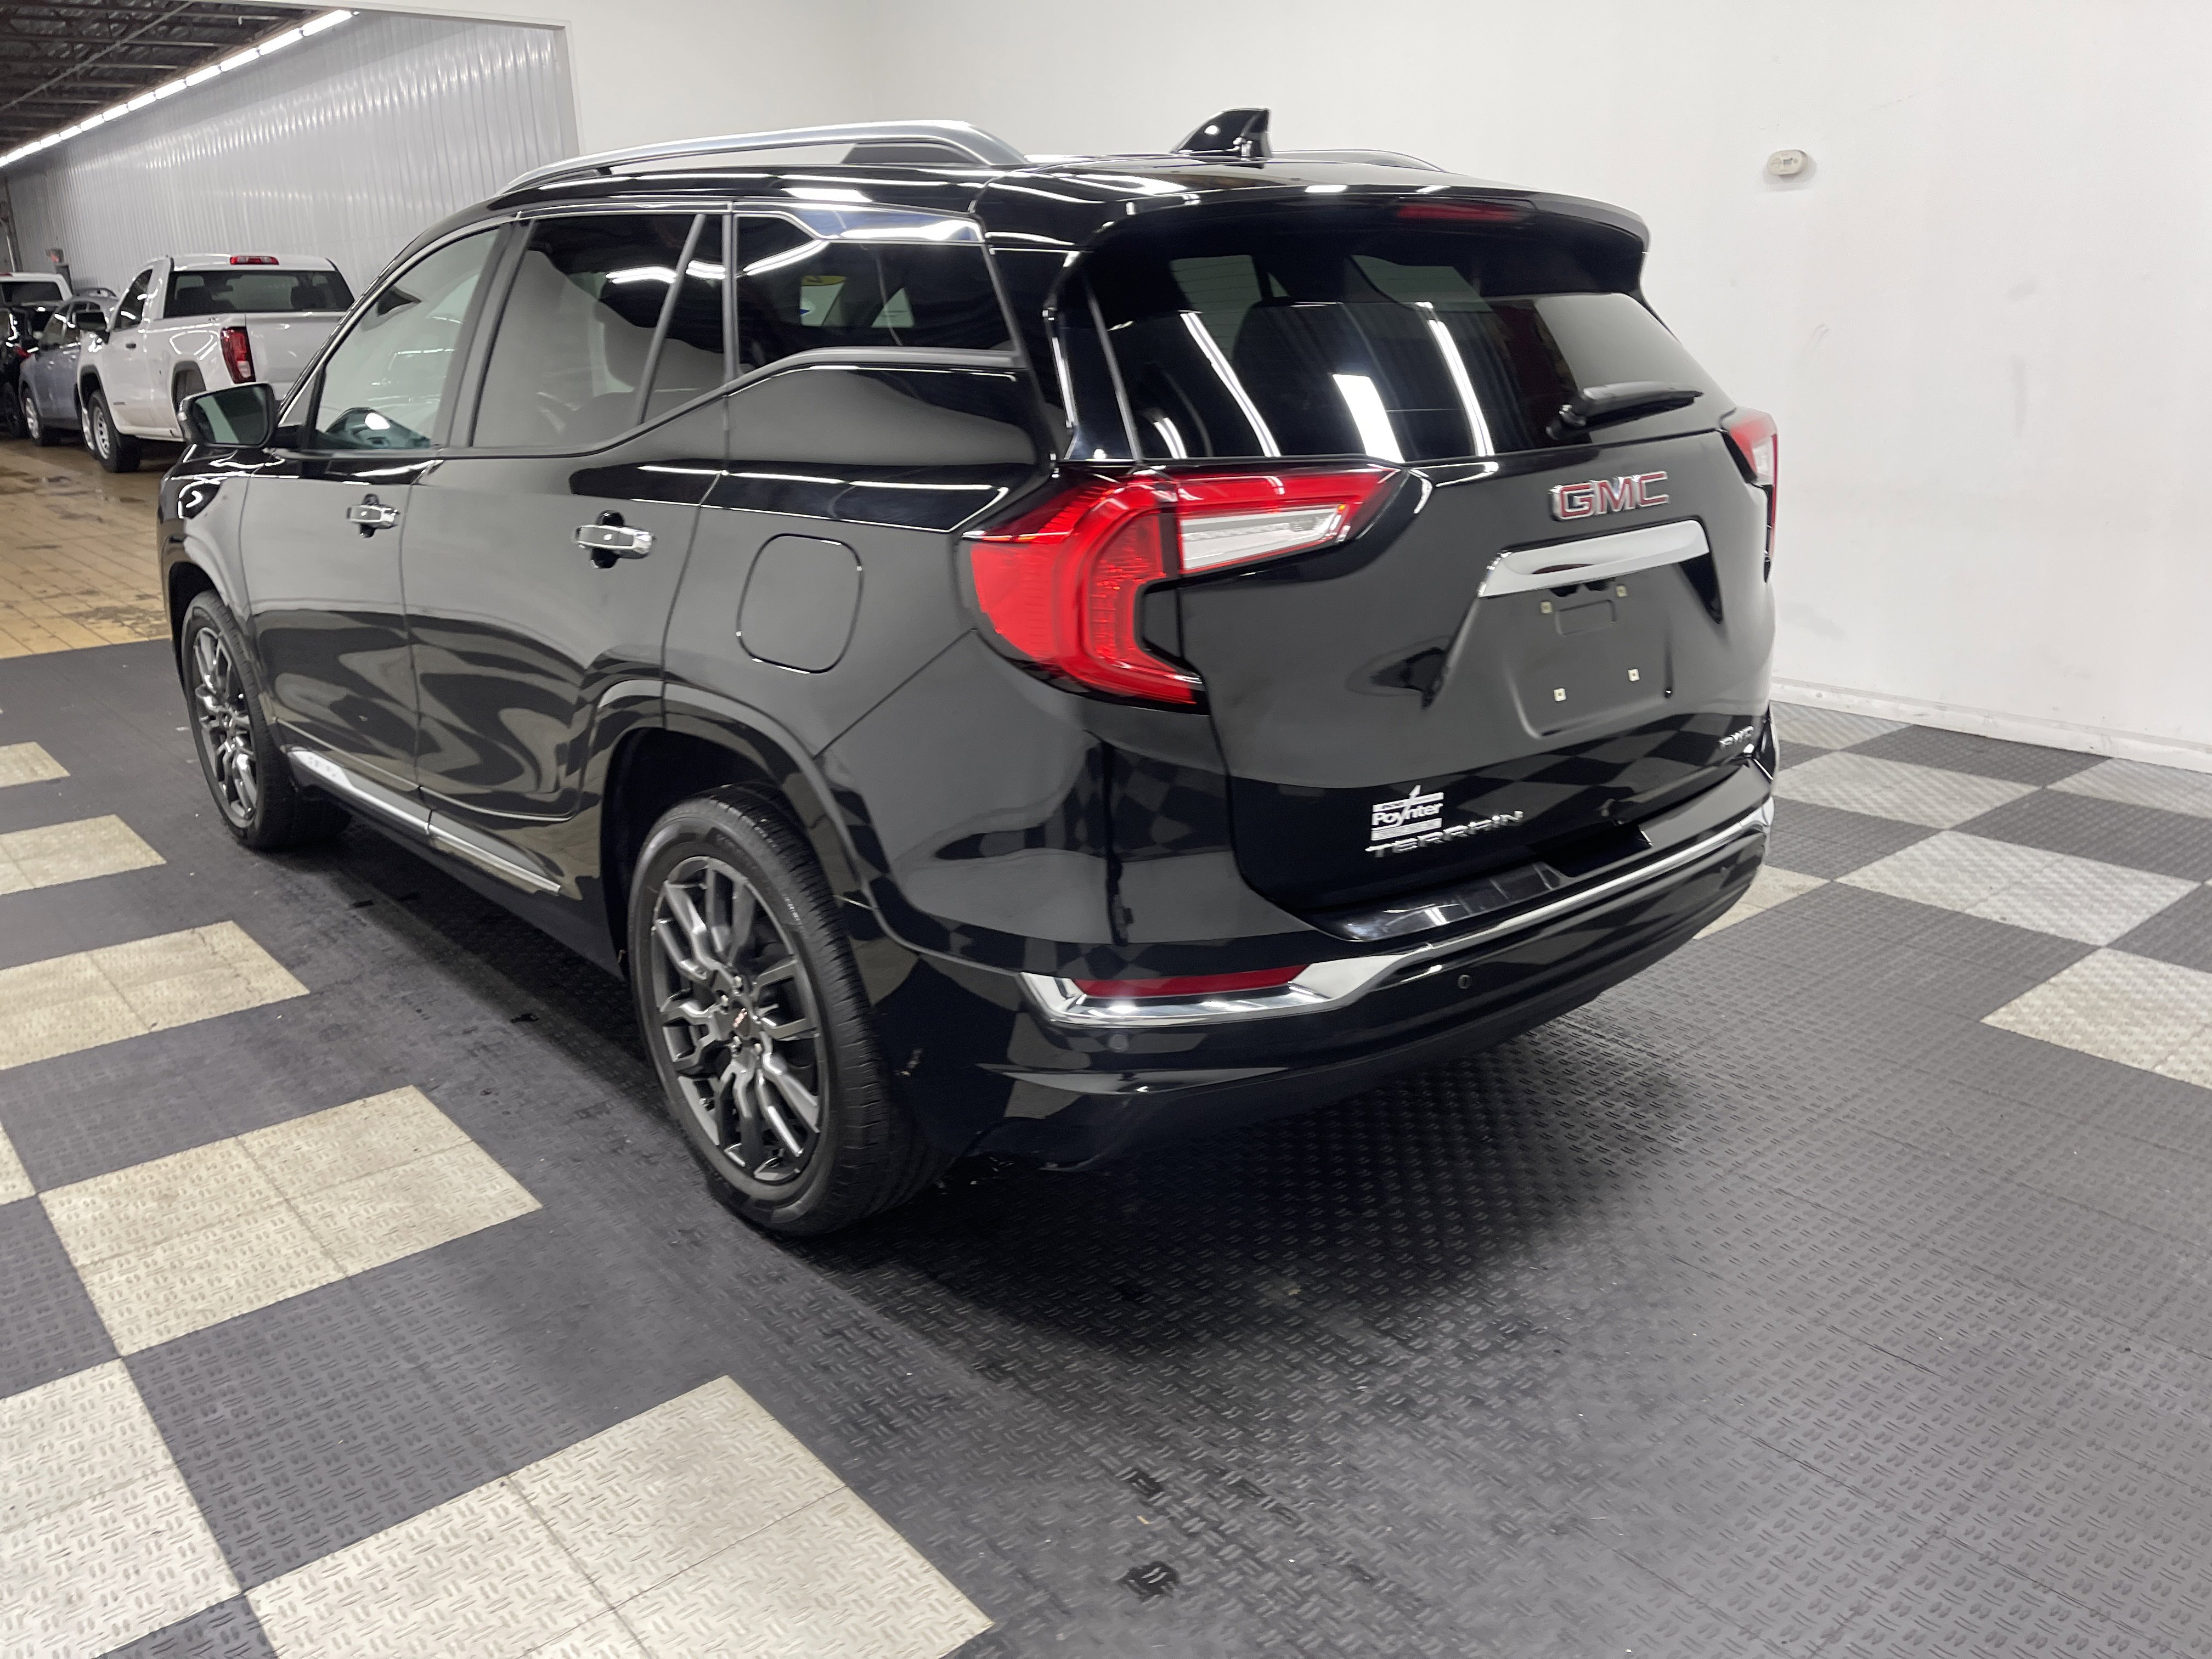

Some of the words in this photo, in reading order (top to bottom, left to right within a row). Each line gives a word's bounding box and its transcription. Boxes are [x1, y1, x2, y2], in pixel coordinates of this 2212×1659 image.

[1549, 471, 1669, 520] GMC
[1365, 810, 1523, 857] TERRAIN
[1372, 794, 1443, 831] Poynter
